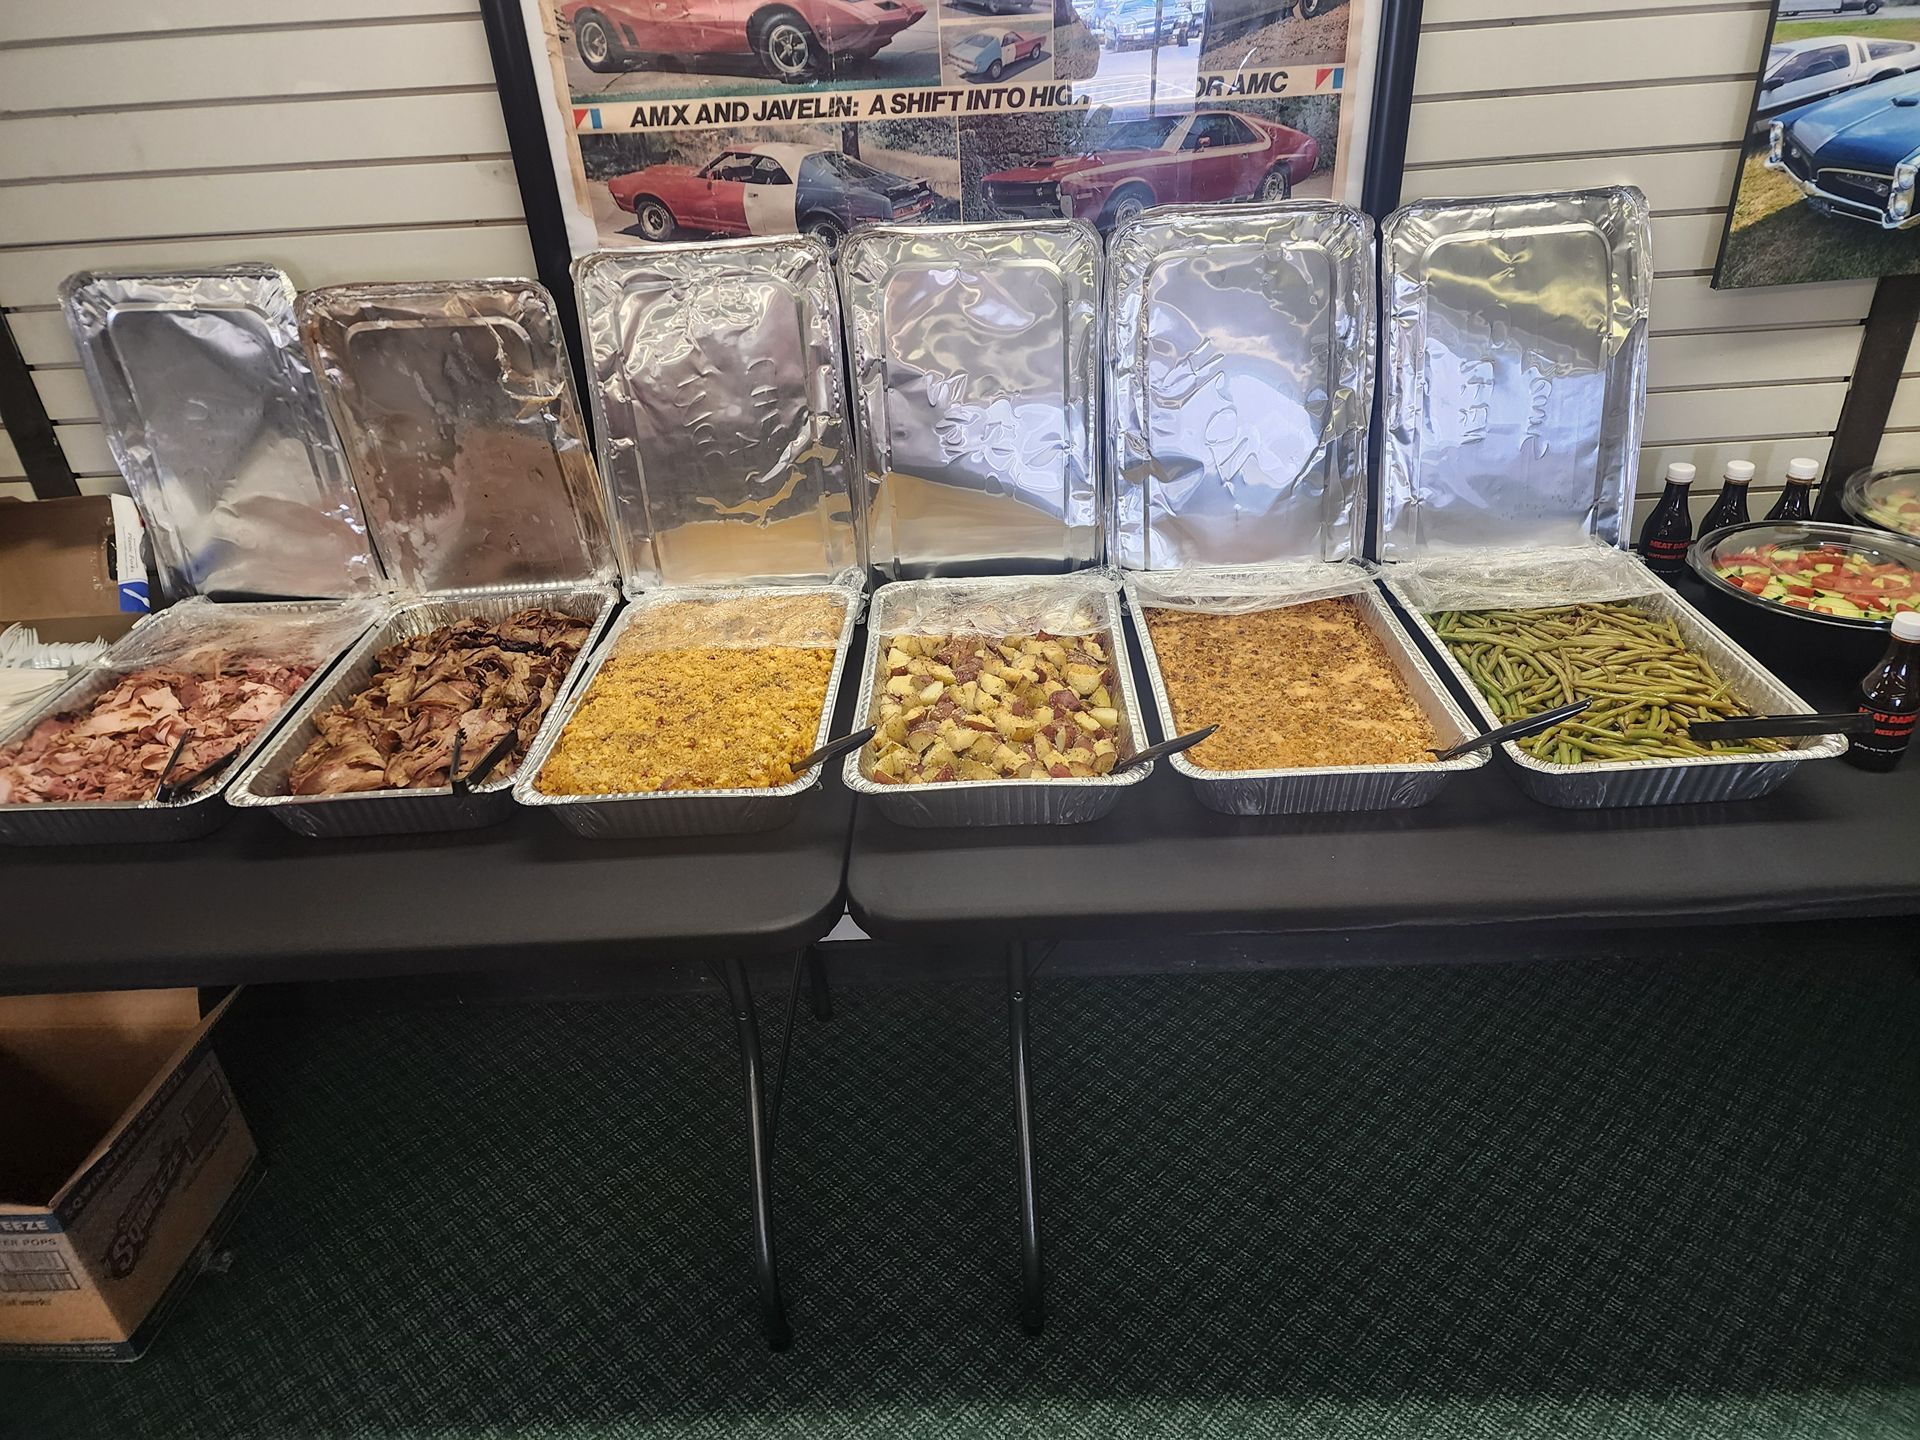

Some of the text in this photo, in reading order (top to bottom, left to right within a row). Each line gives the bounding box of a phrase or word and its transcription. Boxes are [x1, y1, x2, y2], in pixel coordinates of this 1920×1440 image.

[1231, 71, 1288, 95] AMC
[630, 104, 690, 127] AMX
[695, 102, 749, 125] AND
[753, 96, 858, 121] JAVELIN:
[868, 95, 886, 115] A
[891, 90, 964, 115] SHIFT
[966, 87, 1025, 111] INTO
[1648, 540, 1673, 550] MEAT
[22, 1238, 57, 1246] POPS
